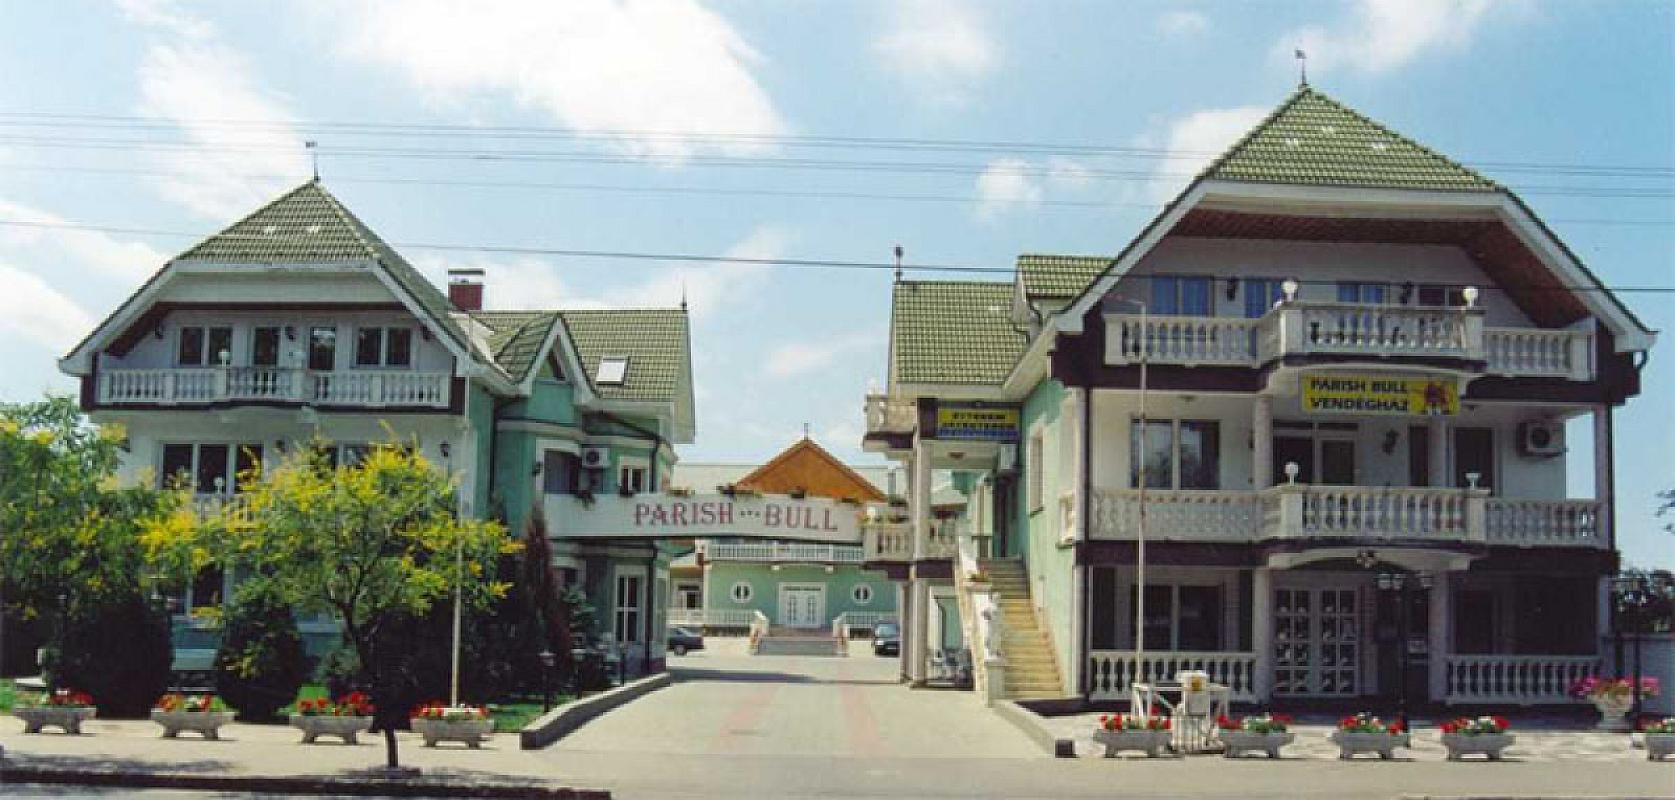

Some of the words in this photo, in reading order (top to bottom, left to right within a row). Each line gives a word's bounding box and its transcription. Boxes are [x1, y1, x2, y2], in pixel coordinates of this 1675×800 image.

[1310, 379, 1366, 392] PARISH
[1372, 379, 1408, 393] BULL
[635, 501, 734, 526] PARISH
[765, 503, 838, 533] BULL
